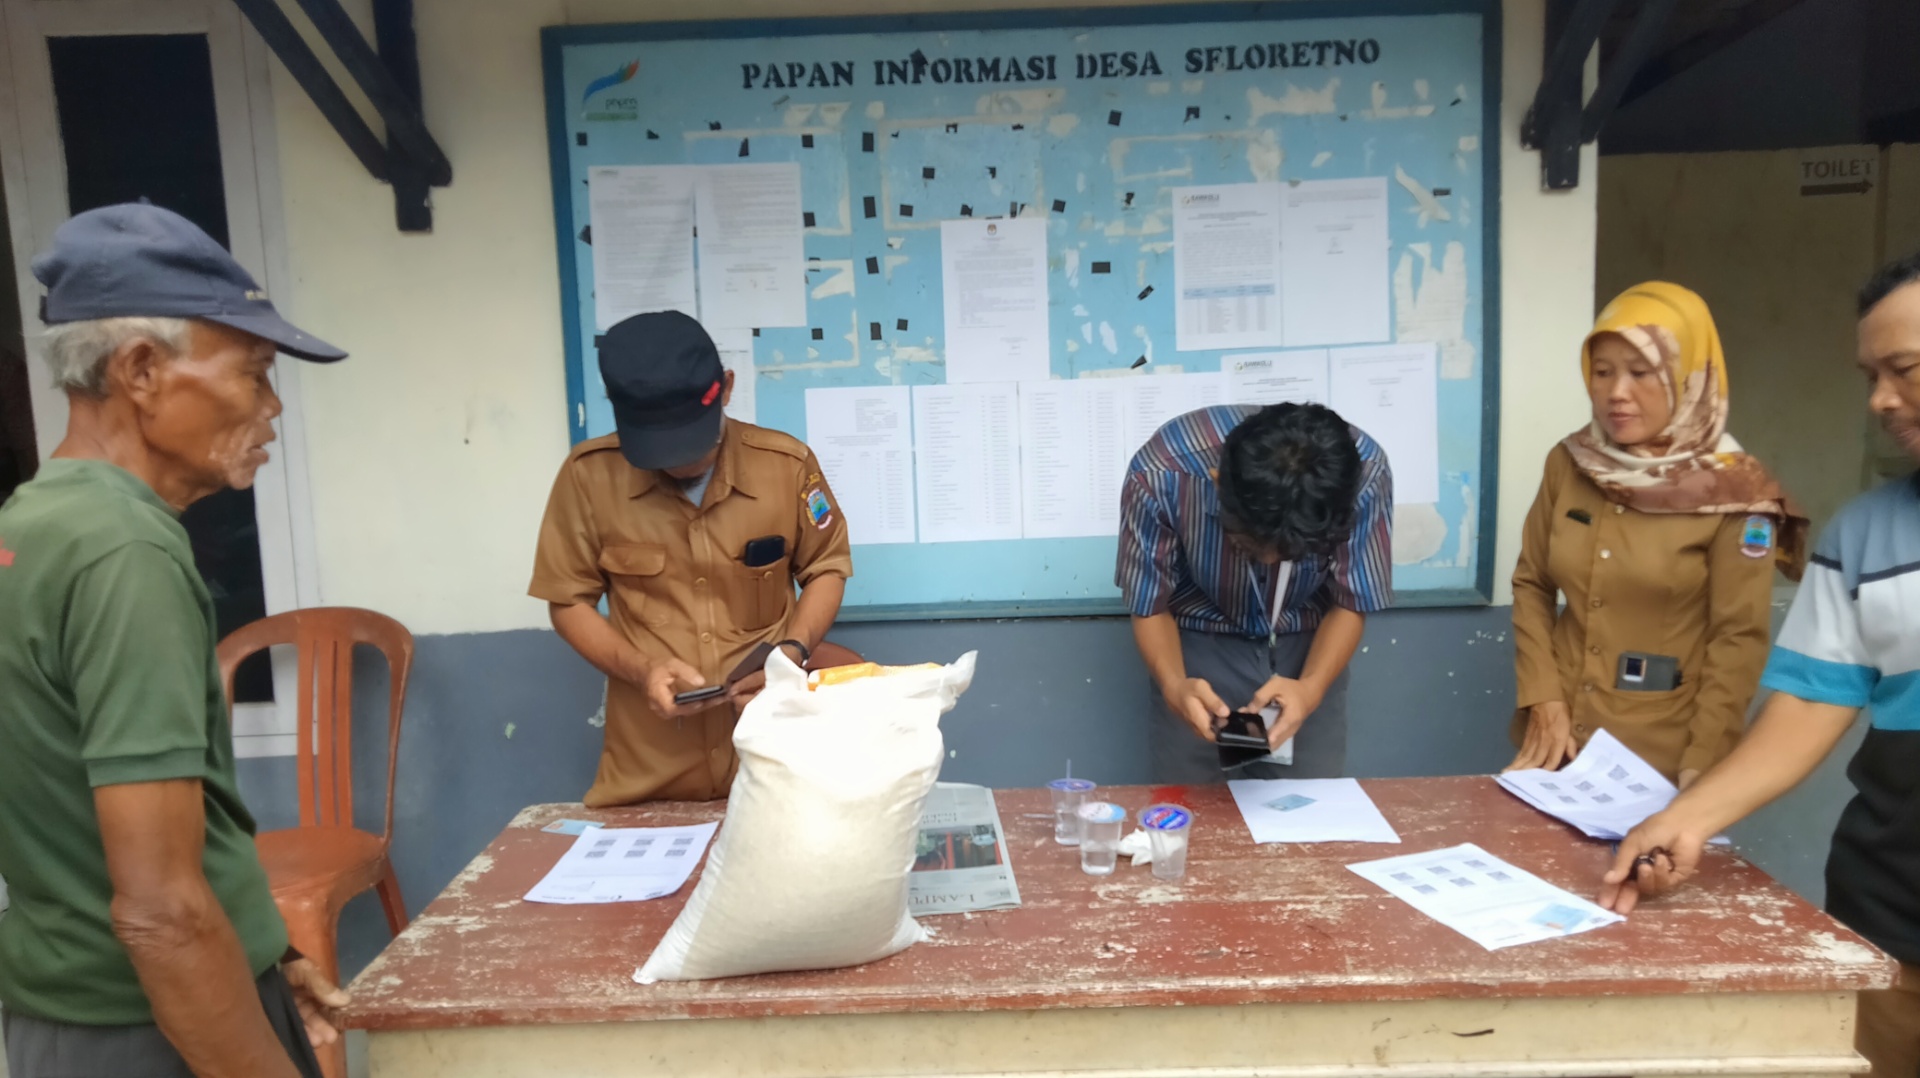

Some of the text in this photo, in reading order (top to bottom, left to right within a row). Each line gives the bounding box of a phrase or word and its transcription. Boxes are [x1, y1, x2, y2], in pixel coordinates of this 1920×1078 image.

[741, 60, 854, 89] PAPAN
[873, 53, 1057, 86] INFORMASI
[1075, 50, 1163, 79] DESA
[1801, 158, 1875, 179] TOILET
